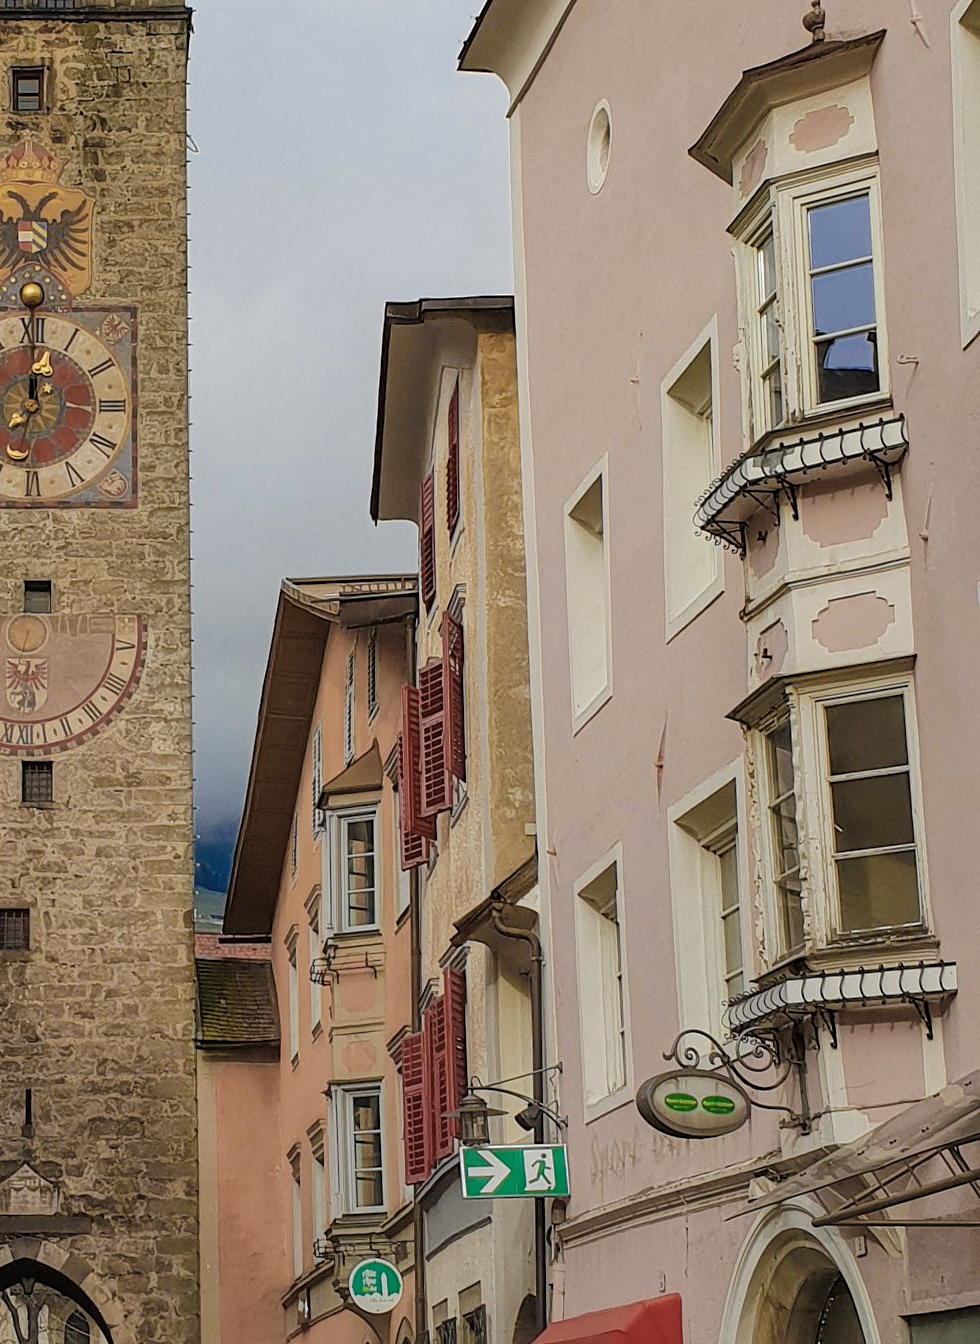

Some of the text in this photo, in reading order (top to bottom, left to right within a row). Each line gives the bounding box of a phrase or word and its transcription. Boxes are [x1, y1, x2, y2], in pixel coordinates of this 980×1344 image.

[19, 318, 46, 343] XII
[64, 328, 79, 352] I
[88, 357, 116, 378] II
[99, 400, 126, 413] III
[24, 471, 41, 497] VI
[65, 461, 85, 487] V
[1, 723, 15, 743] XI
[17, 724, 34, 744] XII
[40, 723, 47, 742] I
[60, 718, 73, 737] II
[82, 700, 102, 722] III
[102, 672, 127, 696] IIII
[116, 639, 135, 652] V
